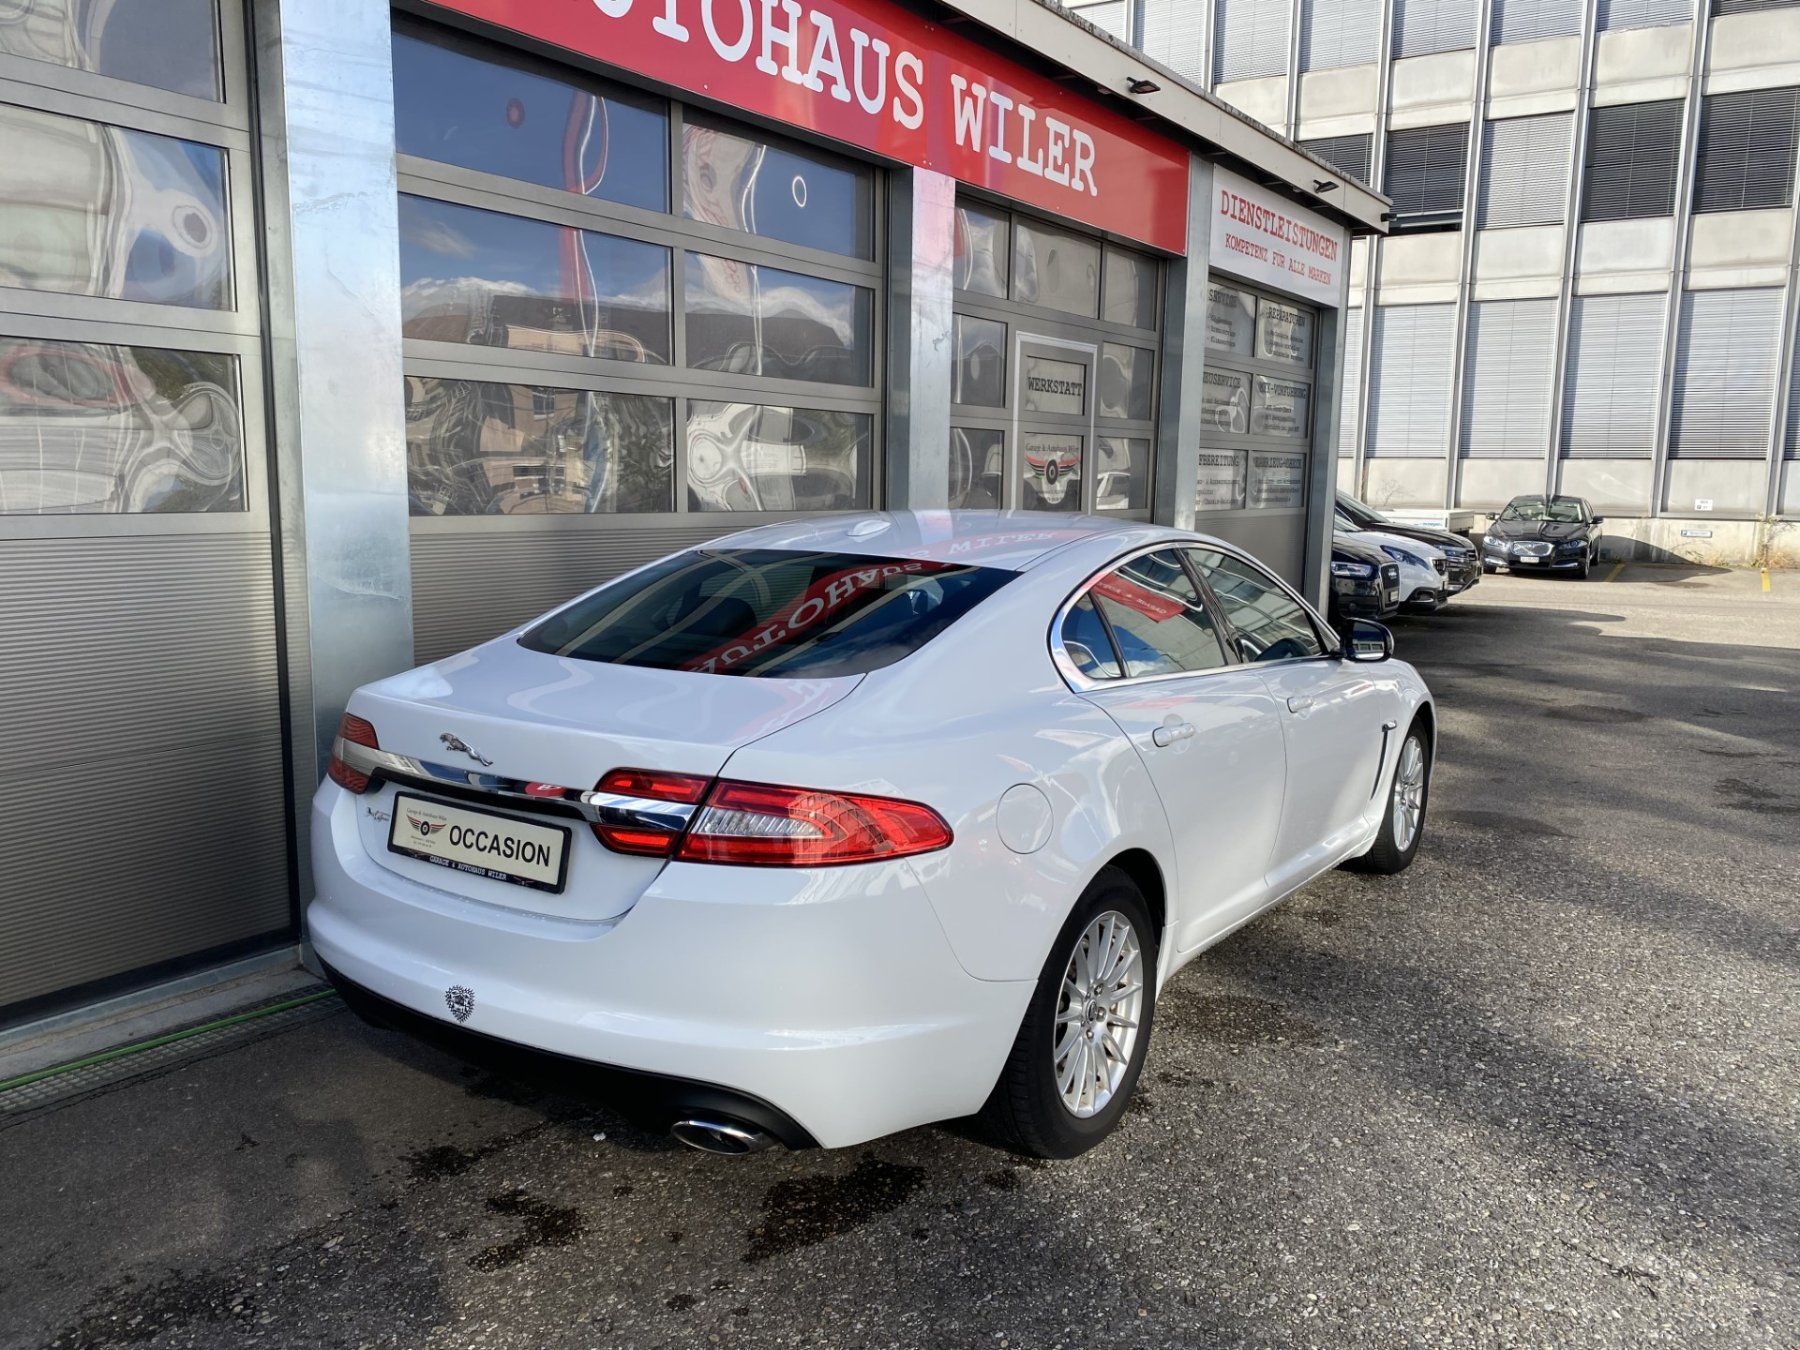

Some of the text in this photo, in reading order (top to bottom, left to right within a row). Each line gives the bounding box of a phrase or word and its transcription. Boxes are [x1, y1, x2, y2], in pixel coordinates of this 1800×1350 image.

[593, 0, 1098, 197] OHAUS WILER
[1221, 190, 1338, 262] DIENSTLEISTUNGEN
[1225, 233, 1268, 262] KOMPETENZ
[1288, 258, 1305, 276] ALLE
[1308, 266, 1331, 284] MARKEN
[1028, 377, 1083, 397] WERKSTATT
[449, 825, 550, 867] OCCASION
[457, 862, 486, 876] AUTOHAUS
[487, 869, 507, 881] WILER
